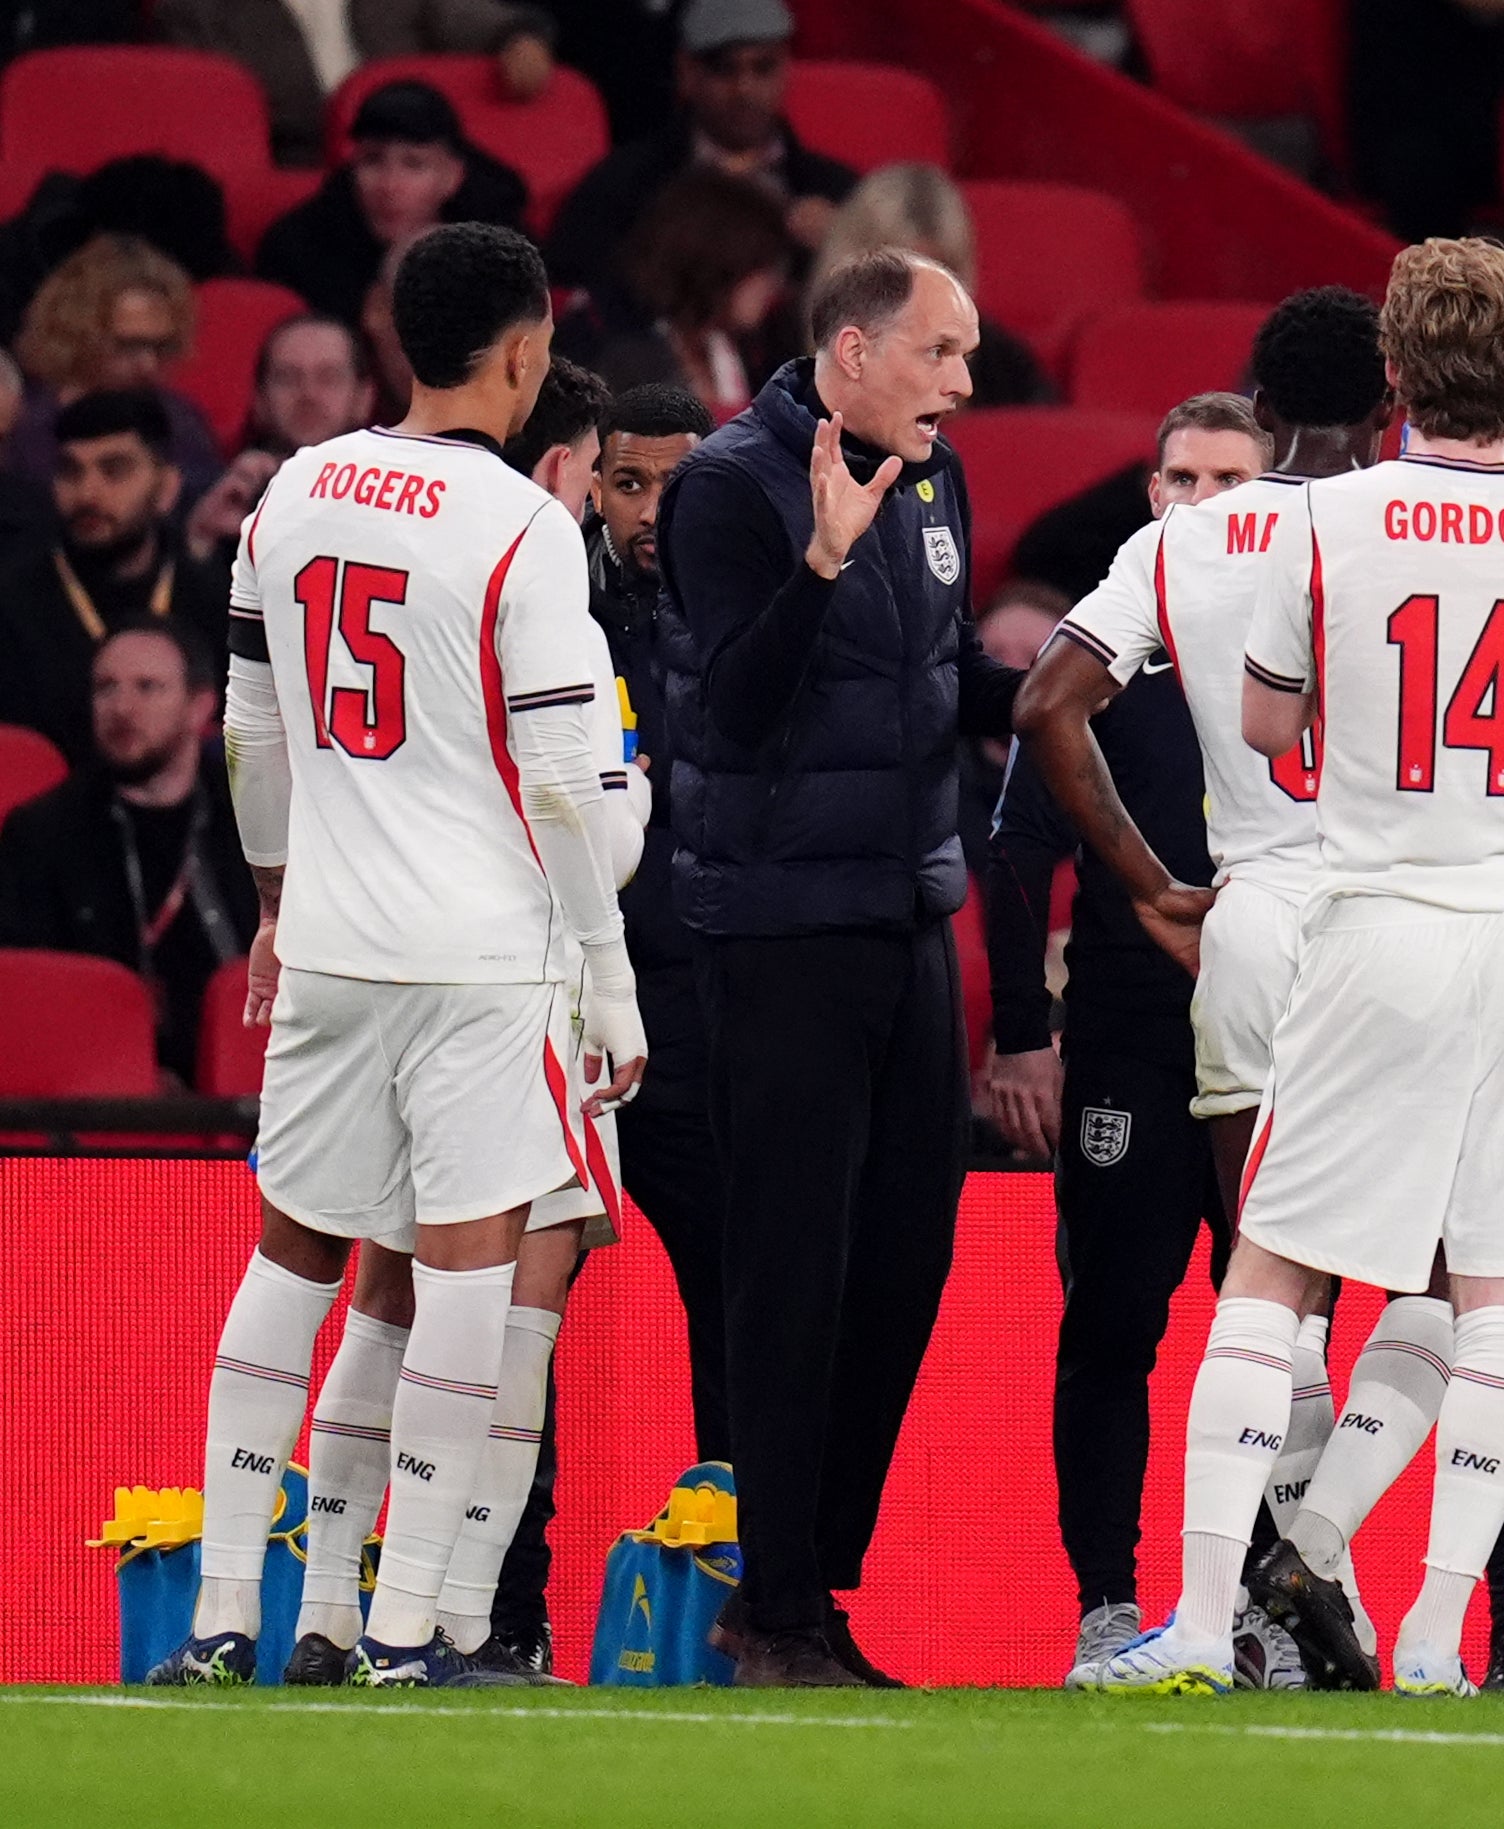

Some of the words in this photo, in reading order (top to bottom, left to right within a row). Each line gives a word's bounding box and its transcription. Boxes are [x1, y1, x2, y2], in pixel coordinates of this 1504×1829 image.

[310, 462, 447, 519] ROGERS
[294, 555, 409, 760] 15
[1340, 1413, 1384, 1435] ENG
[1238, 1427, 1282, 1451] ENG
[232, 1448, 275, 1475] ENG
[397, 1452, 436, 1481] ENG
[1452, 1449, 1500, 1474] ENG
[311, 1496, 347, 1515] ENG
[466, 1505, 491, 1522] NG
